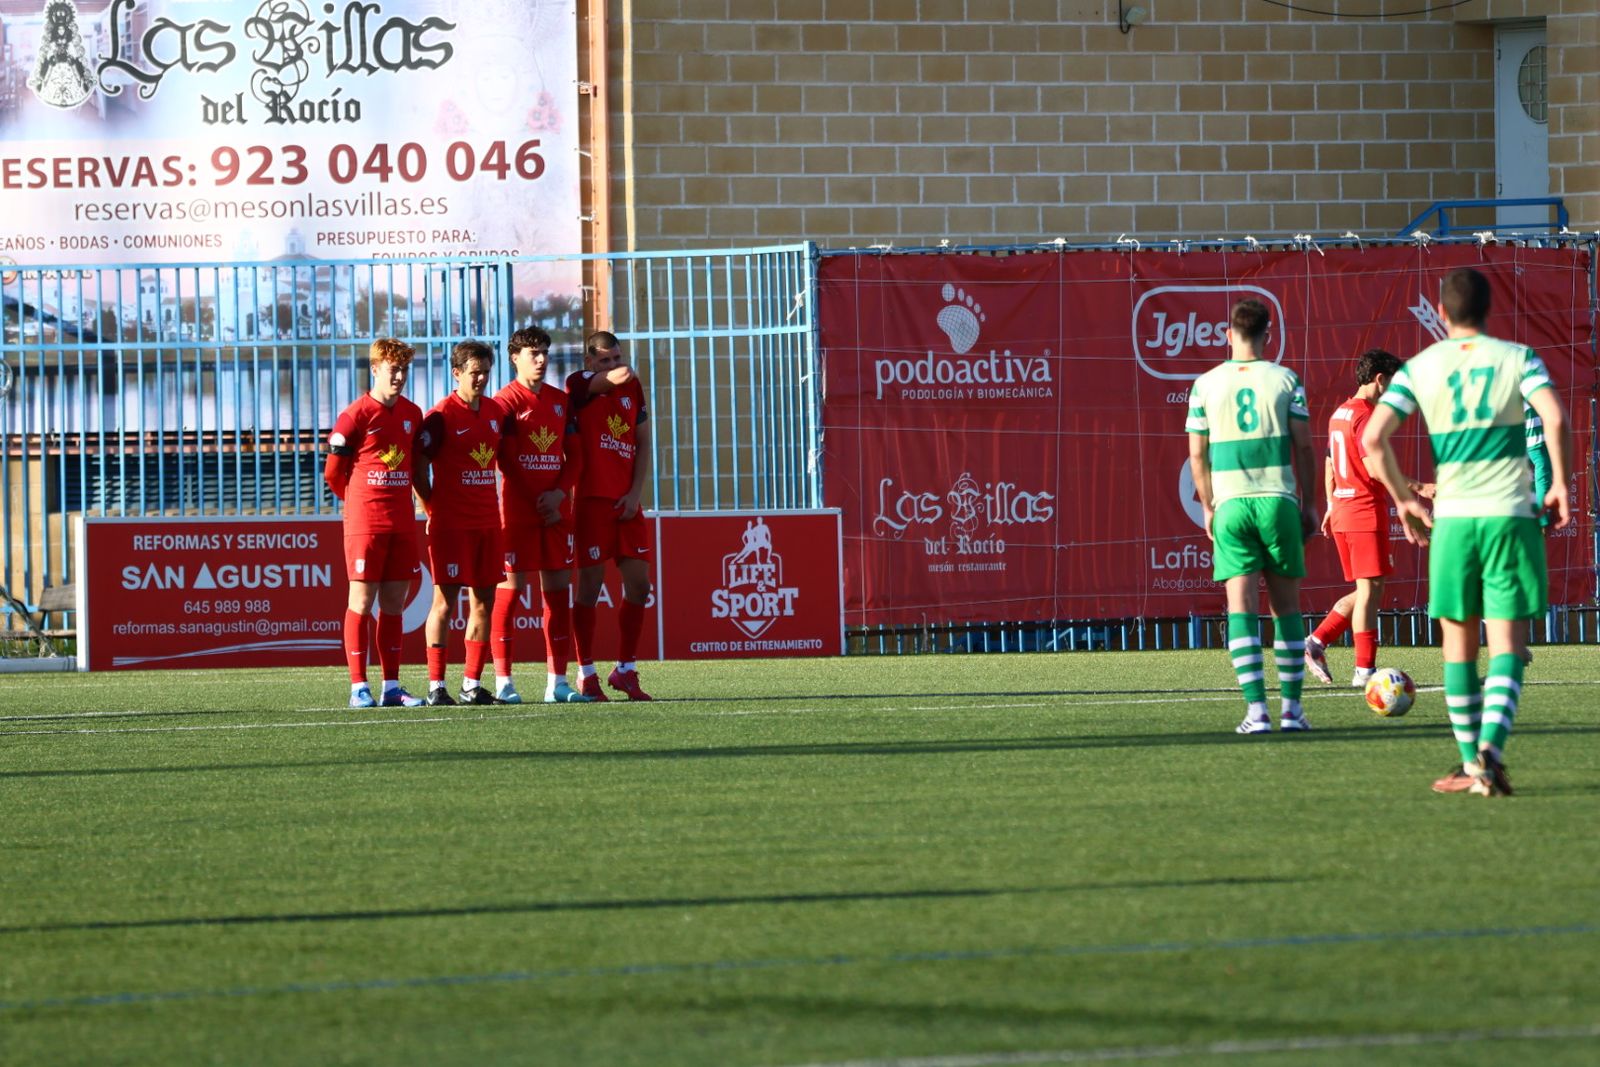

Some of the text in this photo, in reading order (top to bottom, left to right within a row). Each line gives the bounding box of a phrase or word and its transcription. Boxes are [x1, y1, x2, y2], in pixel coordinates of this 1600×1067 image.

[98, 0, 236, 99] Las
[201, 87, 361, 125] del Rocío
[2, 139, 546, 189] ESERVAS: 923 040 046
[75, 191, 448, 221] reservas@mesonlasvillas.es
[60, 235, 109, 250] BODAS
[123, 234, 222, 249] COMUNIONES
[317, 229, 476, 245] PRESUPUESTO PARA:
[875, 350, 1052, 400] podoactiva
[902, 385, 1053, 399] PODOLOGÍA Y BIOMECÁNICA
[1447, 366, 1495, 425] 17
[1236, 388, 1259, 433] 8
[519, 454, 561, 463] CAJA RURA
[367, 470, 388, 479] CAJA
[873, 478, 943, 539] Las
[133, 533, 318, 550] REFORMAS Y SERVICIOS
[923, 533, 1005, 555] del Rocío
[958, 561, 1007, 571] restaurante
[1150, 544, 1215, 570] Lafis
[121, 563, 185, 590] SAN
[728, 564, 776, 588] LIFE
[756, 580, 767, 592] &
[1152, 576, 1216, 591] Abogados
[184, 600, 271, 614] 645 989 988
[711, 587, 799, 618] SPORT
[112, 618, 341, 637] reformas.sanagustin@gmail.com
[690, 639, 823, 653] CENTRO DE ENTRENAMIENTO
